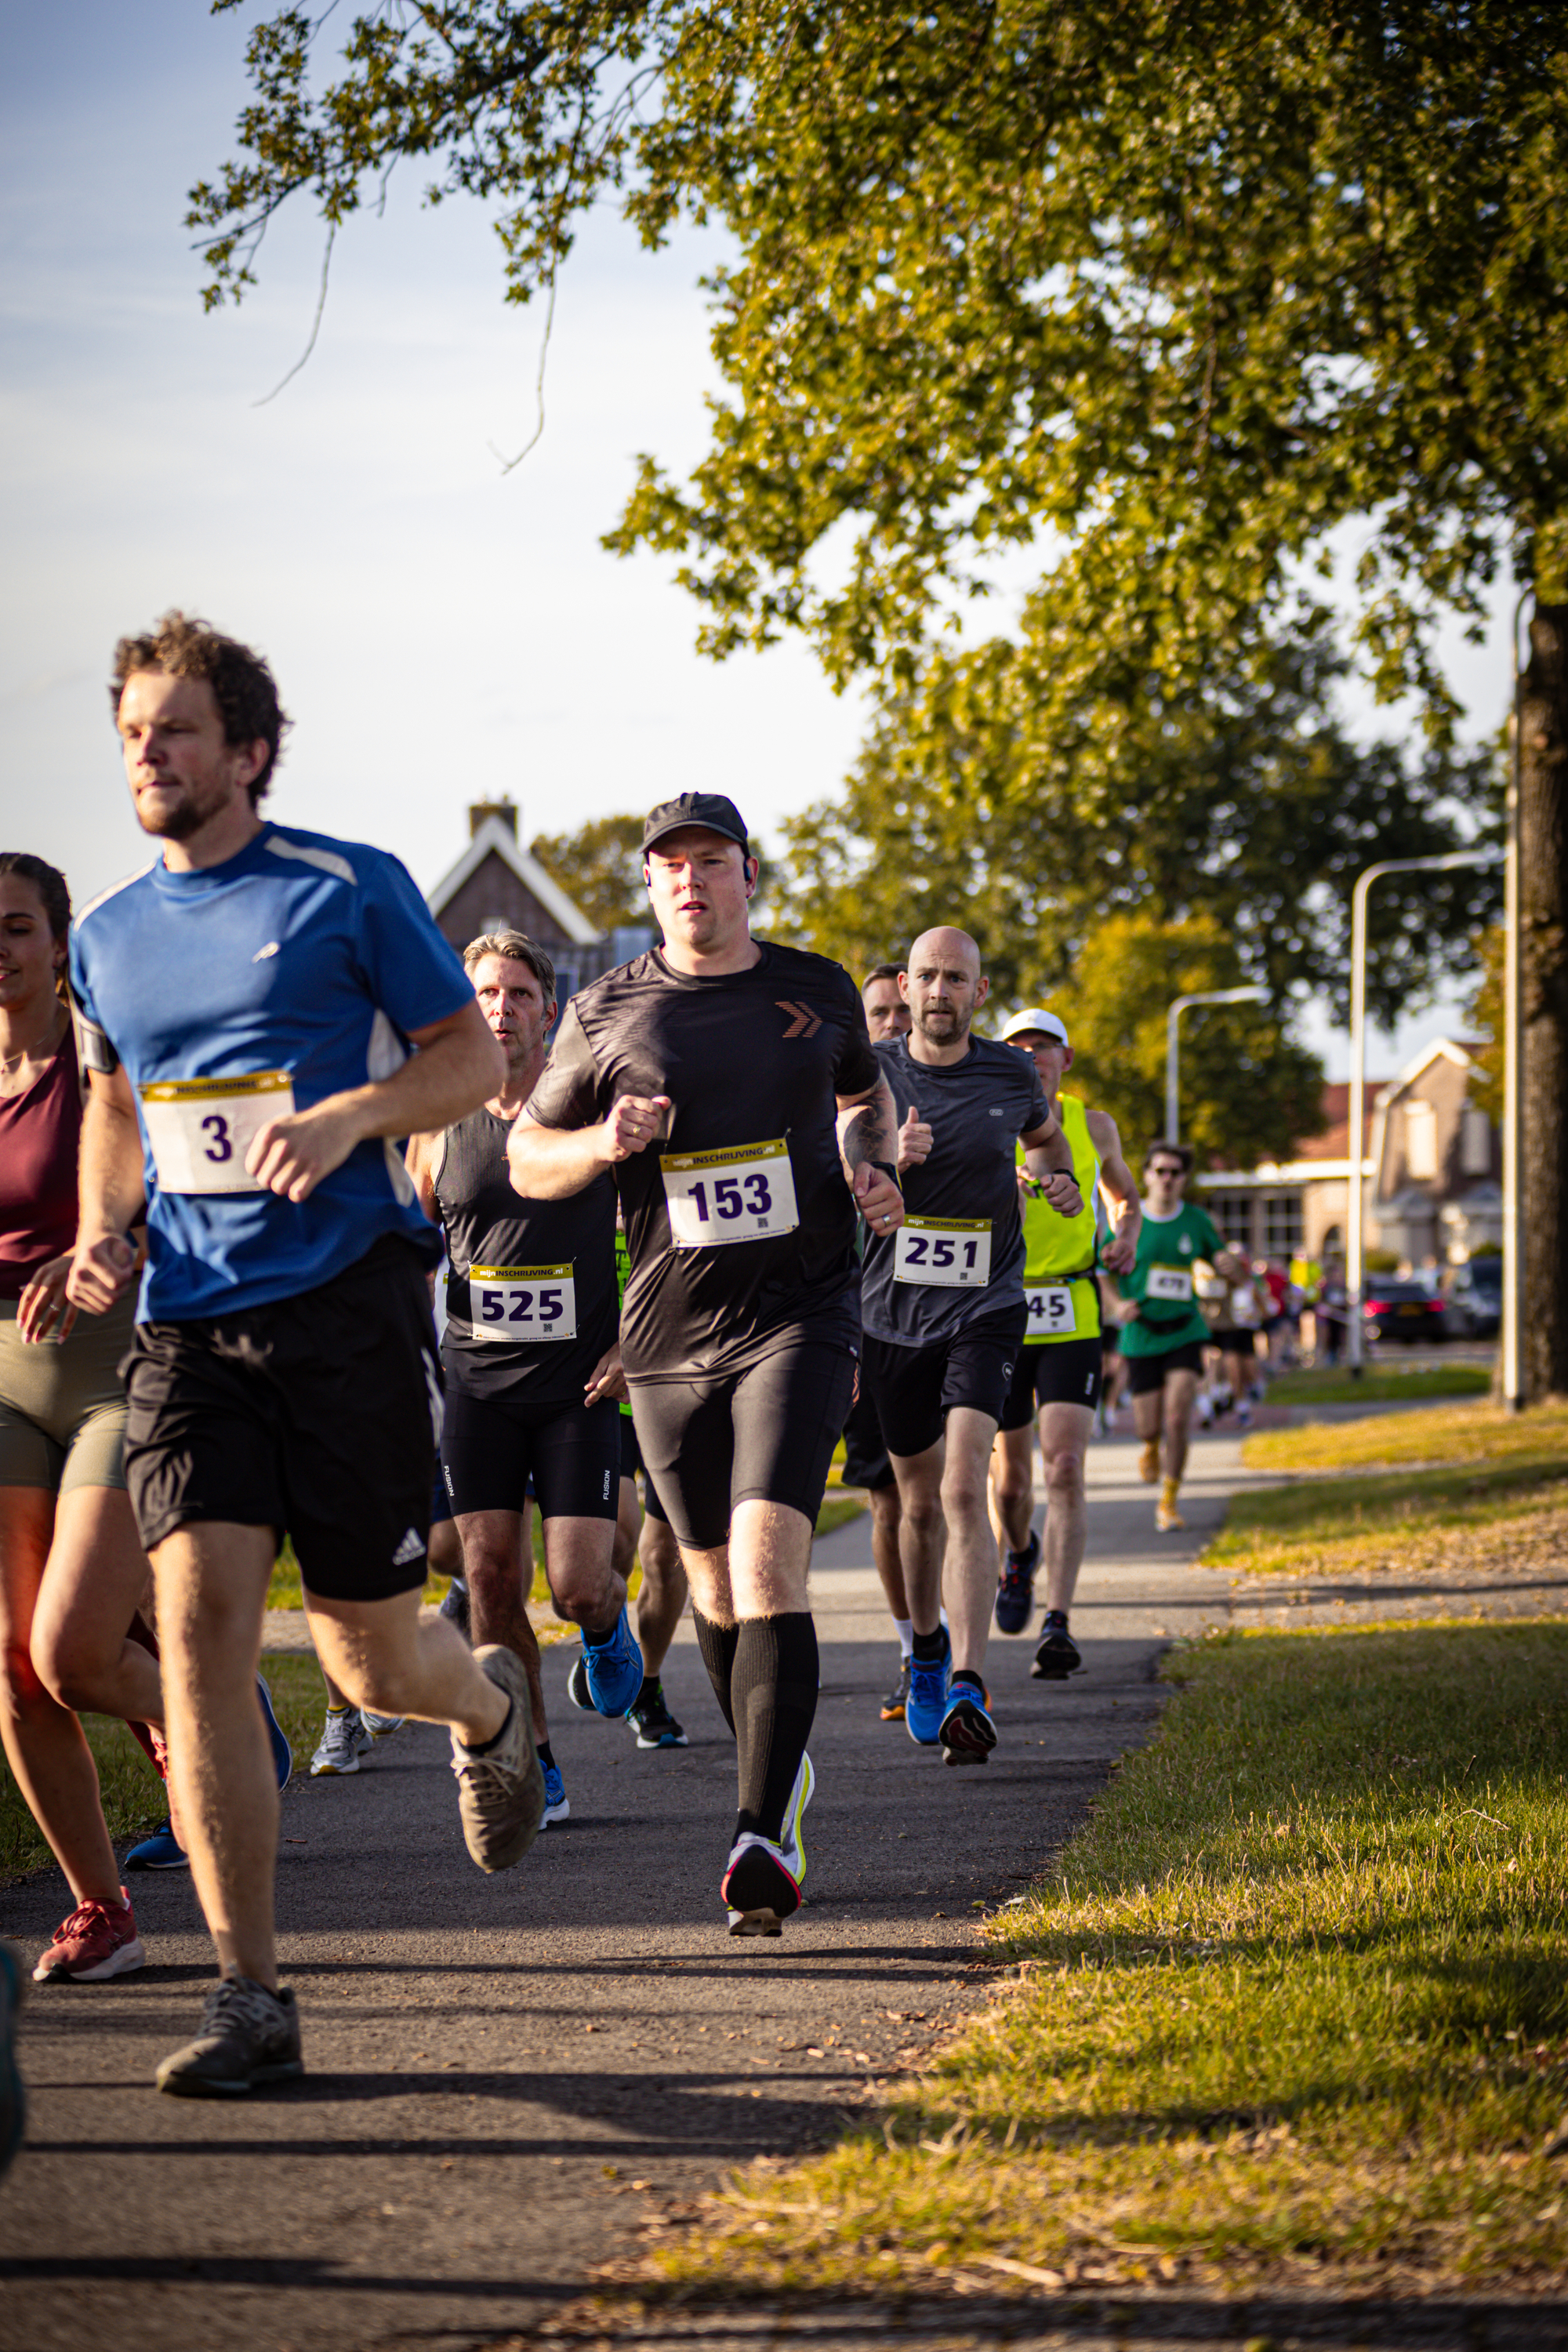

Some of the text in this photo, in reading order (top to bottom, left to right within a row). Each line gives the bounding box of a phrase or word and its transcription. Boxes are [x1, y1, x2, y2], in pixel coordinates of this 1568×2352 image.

[201, 1115, 232, 1163] 3
[688, 1174, 772, 1222] 153
[908, 1218, 984, 1229] mijnINSCHRIJVING.nl
[905, 1236, 978, 1269] 251
[480, 1268, 564, 1278] mijnINSCHRIJVING.nl
[482, 1289, 564, 1322] 525
[444, 1465, 455, 1497] FUSION
